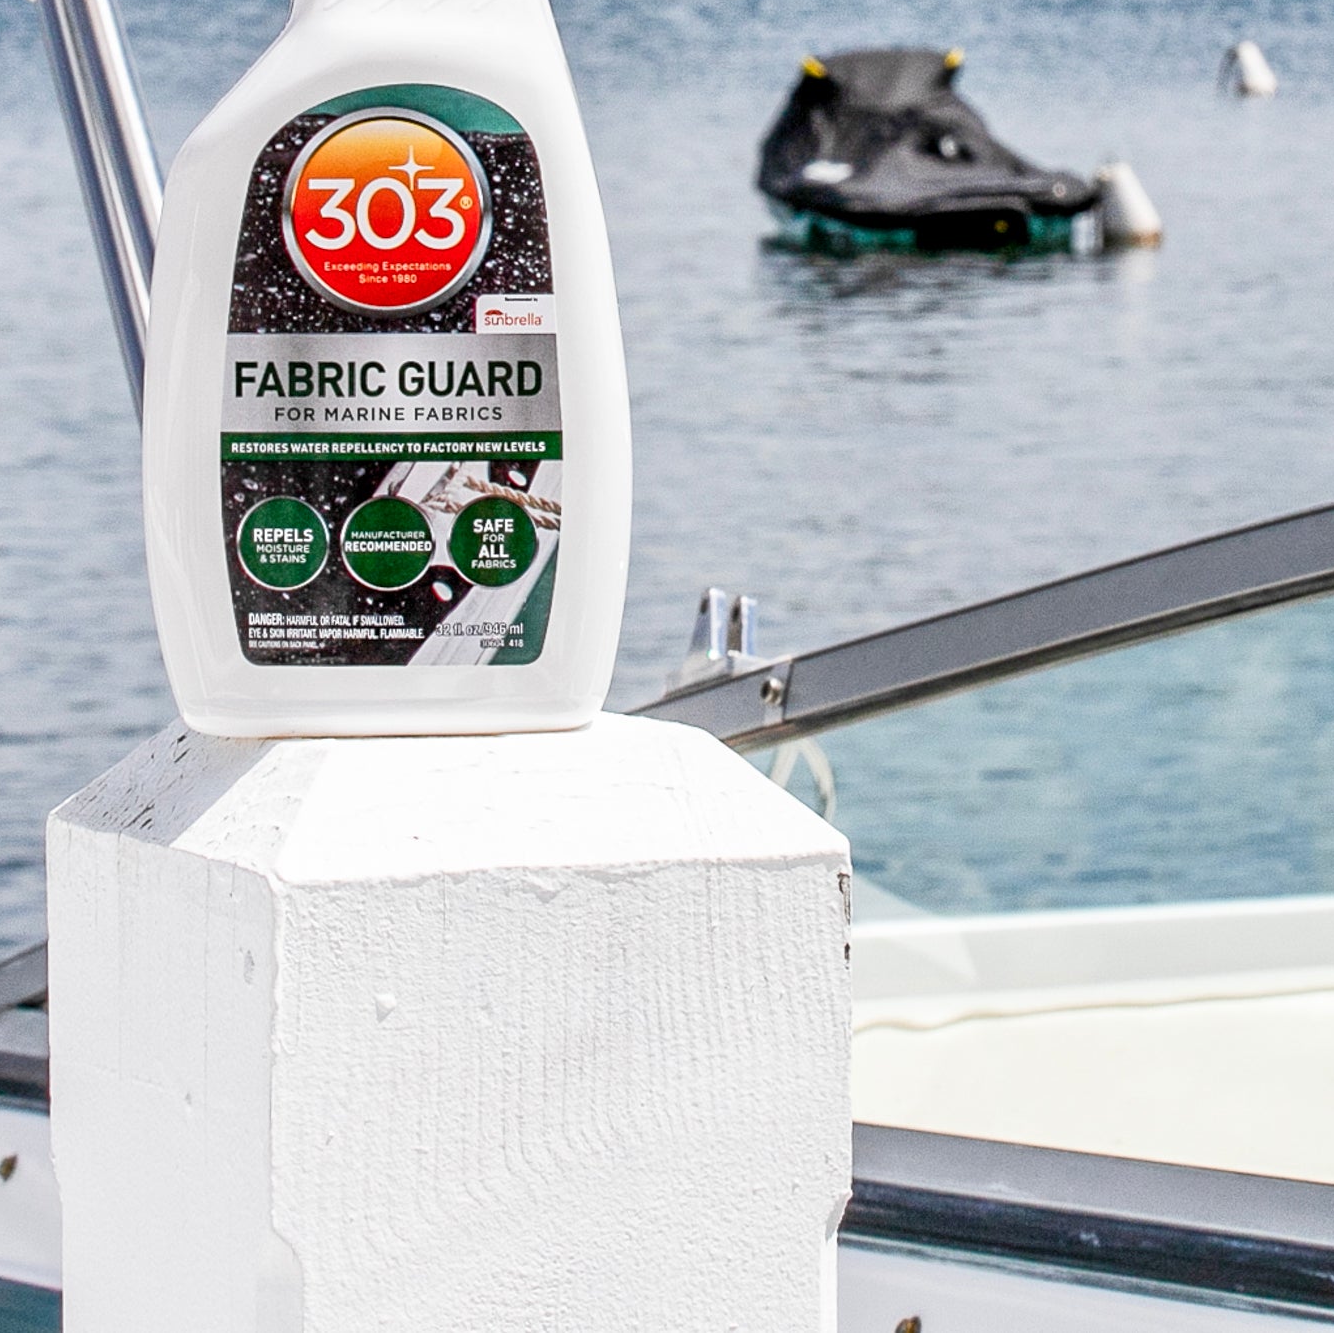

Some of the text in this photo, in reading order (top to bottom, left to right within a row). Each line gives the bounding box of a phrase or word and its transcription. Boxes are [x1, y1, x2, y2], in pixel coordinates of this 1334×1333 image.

[304, 177, 466, 250] 303
[324, 261, 452, 273] Exceeding Expectations
[359, 273, 417, 284] Since 1980
[484, 312, 542, 326] sunbrella
[235, 360, 542, 398] FABRIC GUARD
[274, 406, 502, 421] FOR MARINE FABRICS
[231, 441, 546, 453] RESTORES WATER REPELLENCY TO FACTORY NEW LEVELS
[473, 519, 514, 533] SAFE
[253, 528, 314, 543] REPELS
[351, 531, 425, 540] MANUFACTURER
[482, 534, 505, 543] FOR
[256, 544, 310, 553] MOISTURE
[345, 541, 433, 552] RECOMMENDED
[478, 544, 510, 558] ALL
[260, 554, 307, 564] & STAINS
[471, 559, 517, 569] FABRICS
[248, 612, 285, 626] DANGER:
[287, 615, 319, 626] HARMFUL
[320, 615, 330, 626] OR
[331, 615, 351, 626] FATAL
[248, 627, 261, 638] EYE
[319, 628, 342, 639] VAPOR
[435, 623, 451, 636] 32
[509, 622, 524, 635] ml
